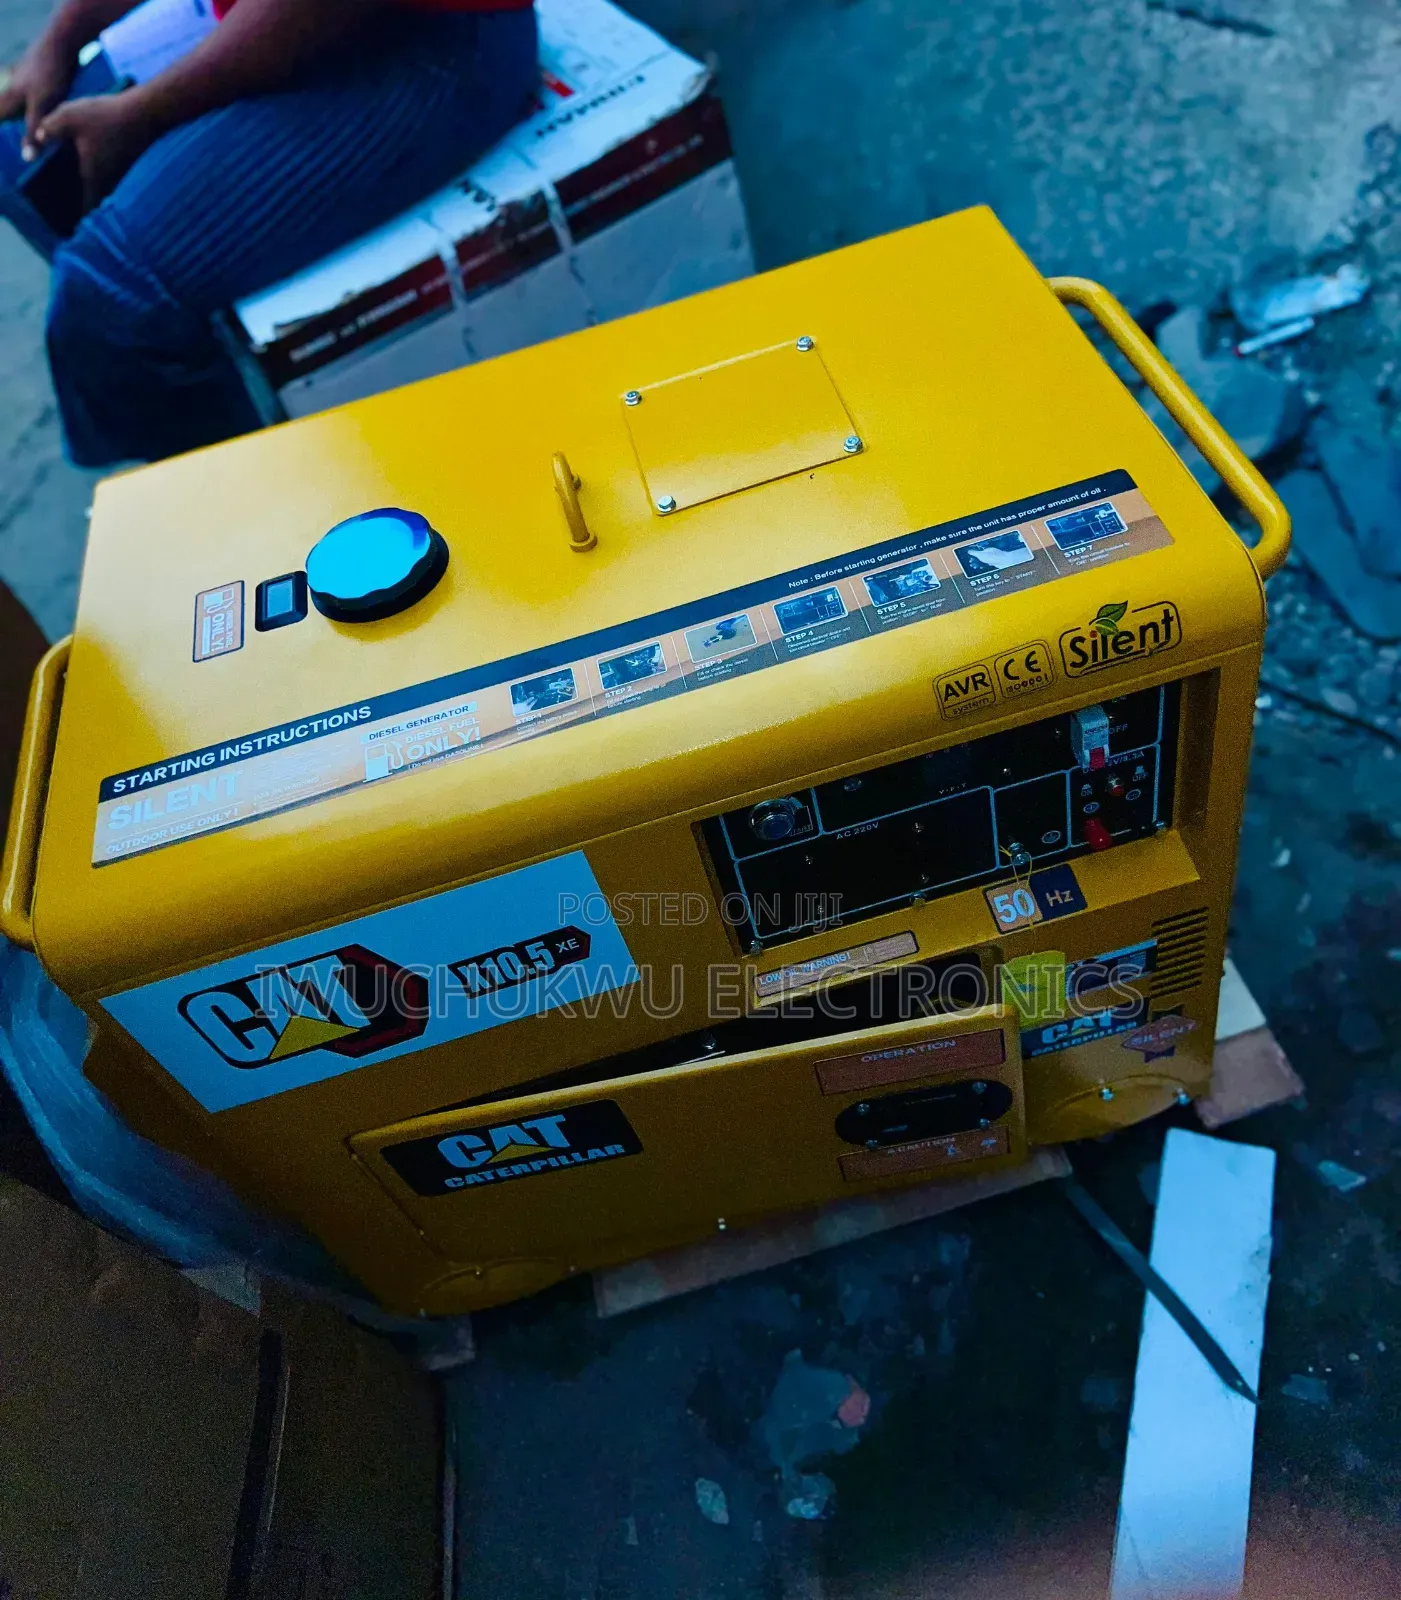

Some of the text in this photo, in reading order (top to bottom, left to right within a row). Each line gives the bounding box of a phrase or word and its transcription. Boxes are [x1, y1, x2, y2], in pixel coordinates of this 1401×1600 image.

[789, 578, 808, 588] Note
[814, 569, 842, 580] Before
[844, 558, 876, 571] starting
[876, 544, 918, 562] generator
[923, 535, 947, 546] make
[948, 529, 968, 540] sure
[968, 523, 983, 534] the
[983, 519, 1000, 528] unit
[1000, 513, 1017, 524] has
[1018, 505, 1046, 518] proper
[1047, 494, 1080, 509] amount
[1080, 490, 1090, 498] of
[1090, 487, 1102, 496] oil
[1064, 547, 1086, 558] STEP
[970, 576, 992, 586] STEP
[877, 604, 898, 615] STEP
[211, 613, 225, 652] ONLY!
[785, 632, 807, 643] STEP
[1069, 608, 1174, 670] Silent
[695, 661, 716, 670] STEP
[1004, 650, 1042, 680] CE
[605, 688, 626, 698] STEP
[943, 671, 990, 704] AVR
[369, 705, 470, 741] DIESEL GENERATOR
[953, 697, 990, 716] system
[405, 717, 480, 744] DIESEL FUEL
[407, 727, 482, 760] ONLY!
[113, 752, 216, 794] STARTING
[220, 705, 372, 762] INSTRUCTIONS
[108, 772, 239, 830] SILENT
[1081, 788, 1093, 797] ON
[106, 829, 168, 855] OUTDOOR
[170, 822, 195, 836] USE
[836, 822, 880, 840] AC 220V
[993, 889, 1074, 924] 50 Hz
[457, 938, 580, 994] X10.5 XE
[759, 952, 852, 985] LOW OIL WARNING!
[186, 954, 372, 1062] CAT
[1042, 1008, 1118, 1044] CAT
[1131, 1019, 1196, 1046] SILENT
[861, 1039, 957, 1062] OPERATION
[438, 1114, 572, 1170] CAT
[444, 1144, 626, 1188] CATERPILLAR
